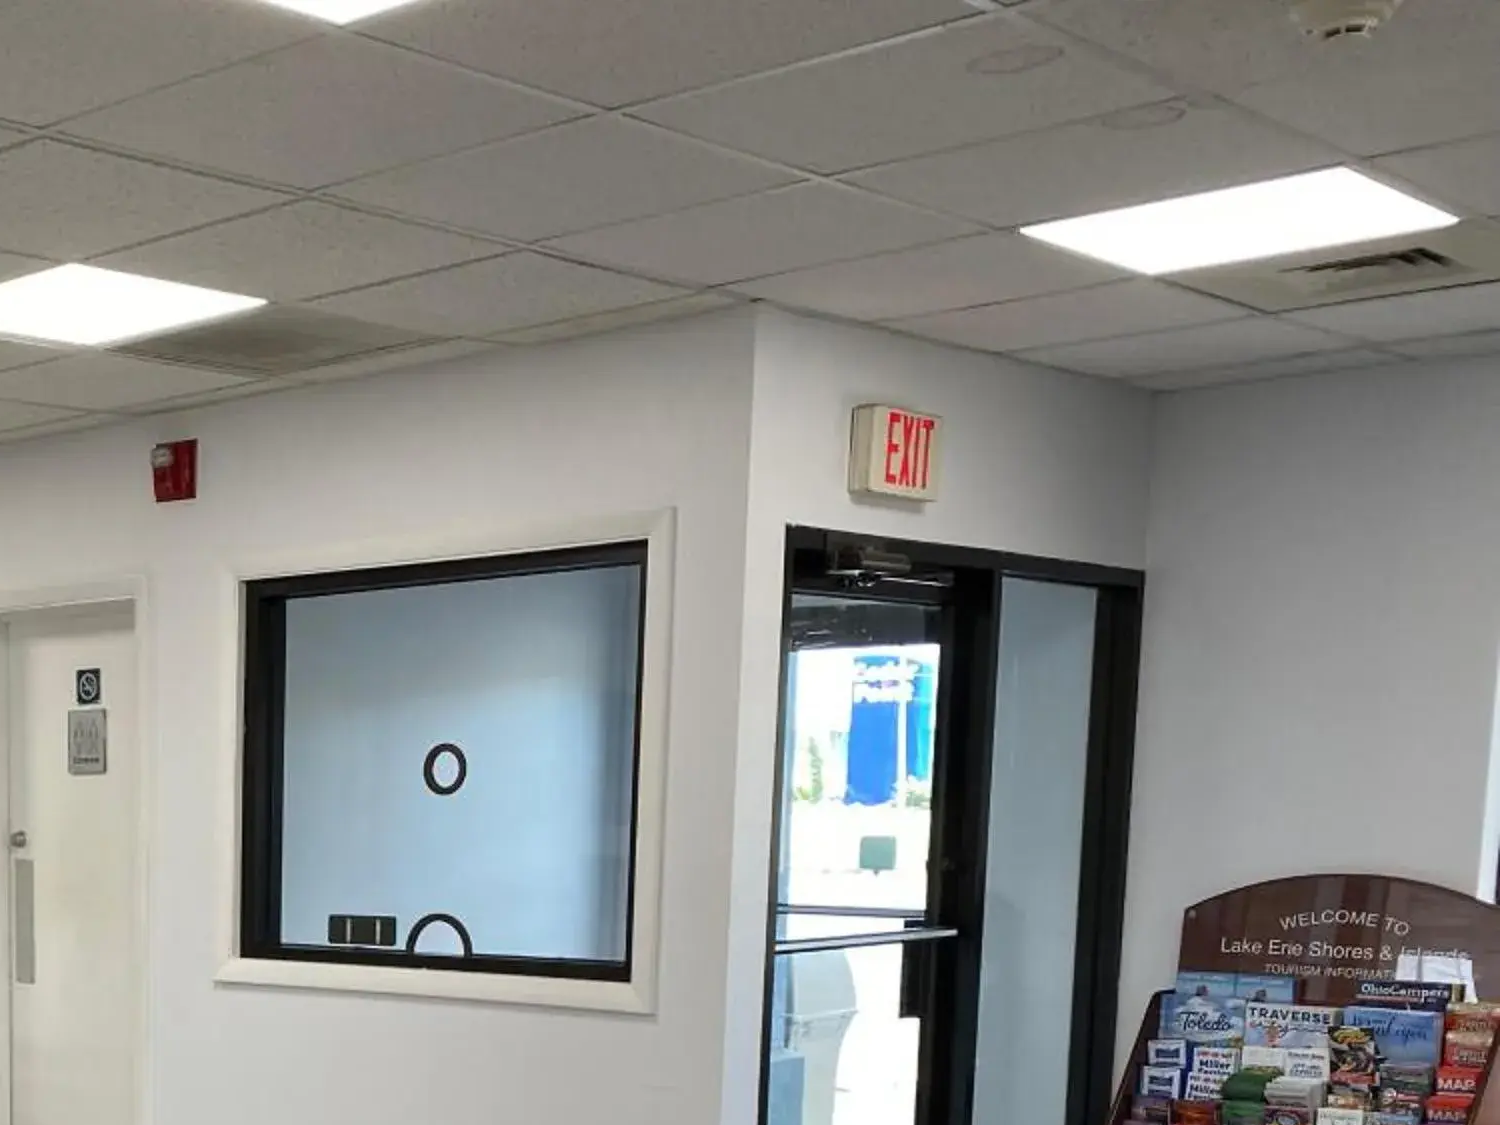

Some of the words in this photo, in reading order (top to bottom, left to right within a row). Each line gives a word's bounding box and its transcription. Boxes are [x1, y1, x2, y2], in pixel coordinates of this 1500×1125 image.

[884, 411, 935, 490] EXIT
[1279, 908, 1378, 931] WELCOME
[1384, 915, 1411, 936] TO
[1220, 937, 1263, 954] Lake
[1268, 939, 1303, 957] Erie
[1308, 940, 1374, 960] Shores
[1379, 944, 1393, 961] &
[1323, 966, 1397, 981] INFORMAT
[1178, 1010, 1233, 1032] Toledo
[1249, 1006, 1333, 1025] TRAVERSE
[1436, 1077, 1476, 1091] MAP
